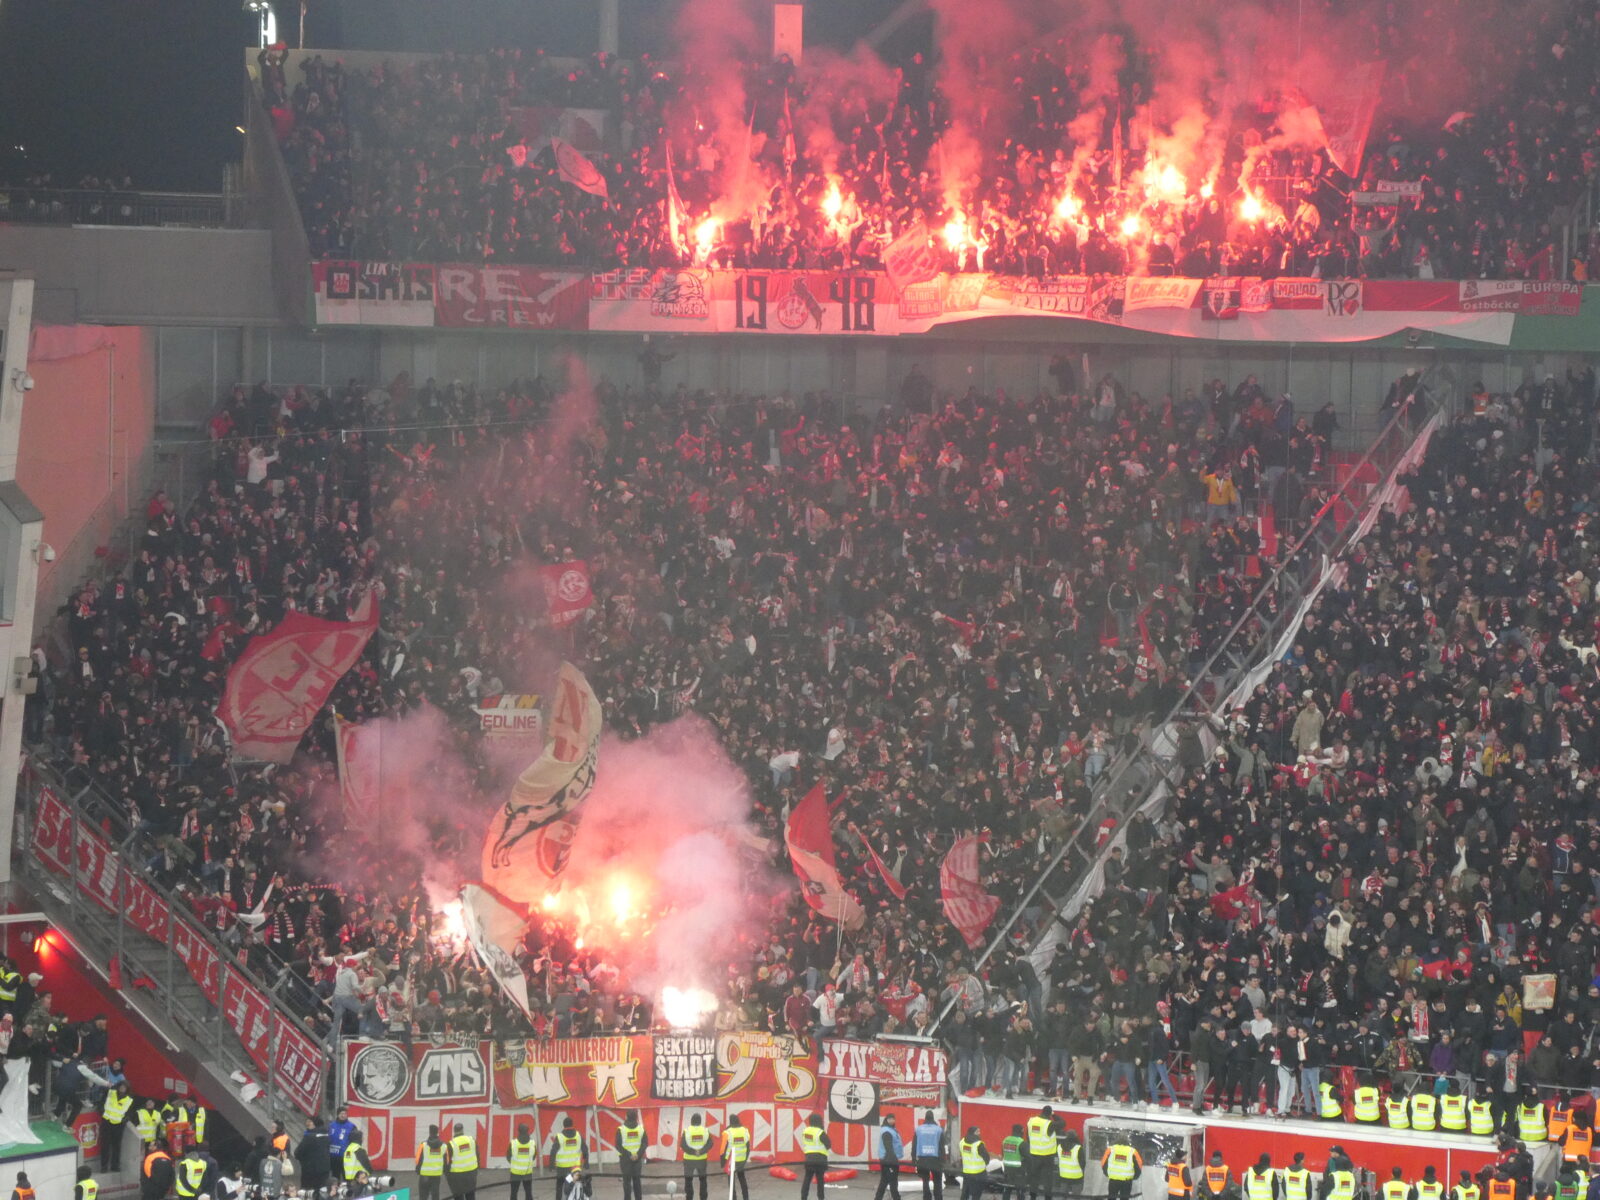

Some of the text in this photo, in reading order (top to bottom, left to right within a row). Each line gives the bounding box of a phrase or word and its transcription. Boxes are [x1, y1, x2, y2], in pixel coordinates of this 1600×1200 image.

[1327, 282, 1359, 300] DO
[1523, 281, 1579, 295] EUROPA
[735, 275, 876, 331] 19 48
[1015, 295, 1084, 312] RADAU
[463, 309, 556, 325] CREW
[526, 1037, 622, 1064] STADIONVERBOT
[655, 1037, 715, 1055] SEKTION
[655, 1054, 715, 1079] STADT
[818, 1042, 948, 1082] SYNKAT
[420, 1053, 482, 1096] CNS
[655, 1078, 715, 1098] VERBOT
